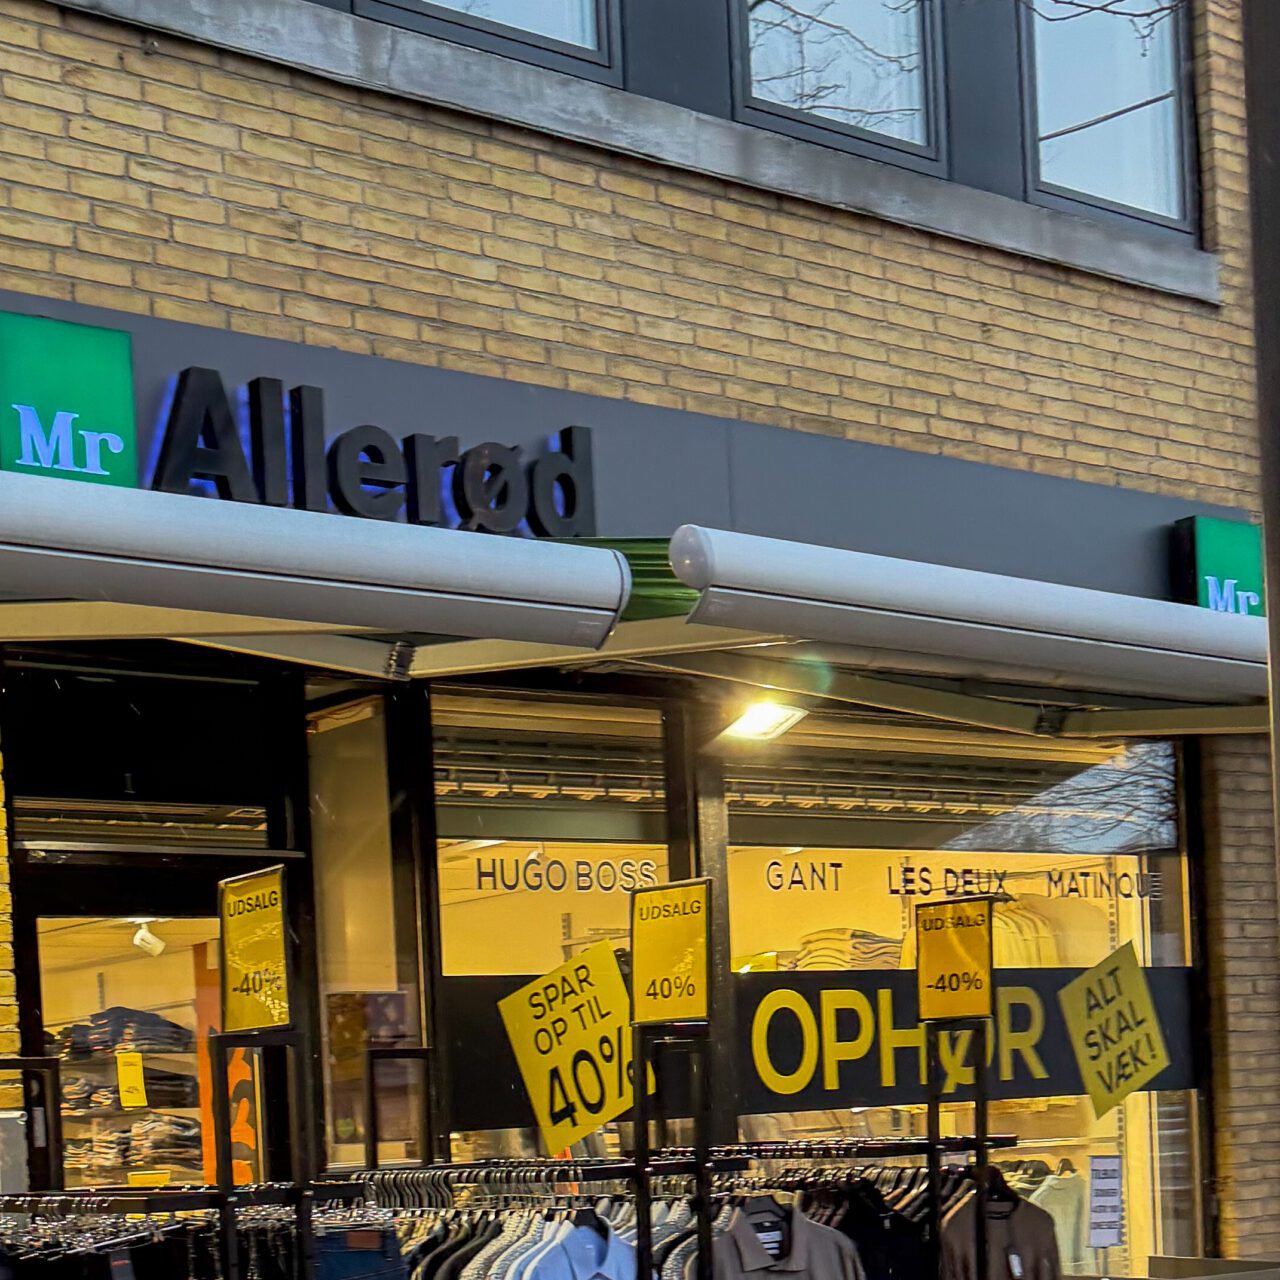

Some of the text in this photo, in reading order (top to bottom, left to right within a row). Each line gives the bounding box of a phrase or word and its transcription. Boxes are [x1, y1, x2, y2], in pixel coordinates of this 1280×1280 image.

[12, 366, 596, 539] Mr Allerød
[1203, 575, 1260, 616] Mr
[476, 858, 658, 893] HUGO BOSS
[766, 861, 843, 891] GANT
[887, 865, 1008, 897] LES DEUX
[226, 890, 279, 917] UDSALG
[639, 899, 702, 921] UDSALG
[922, 913, 986, 932] UDSALG
[528, 964, 595, 1021] SPAR
[645, 975, 696, 1000] 40%
[926, 971, 984, 993] -40%
[1085, 966, 1124, 1020] ALT
[534, 995, 612, 1056] OP TIL
[1084, 1001, 1146, 1061] SKAL
[549, 1025, 635, 1128] 40%
[1096, 1032, 1157, 1094] VÆK!
